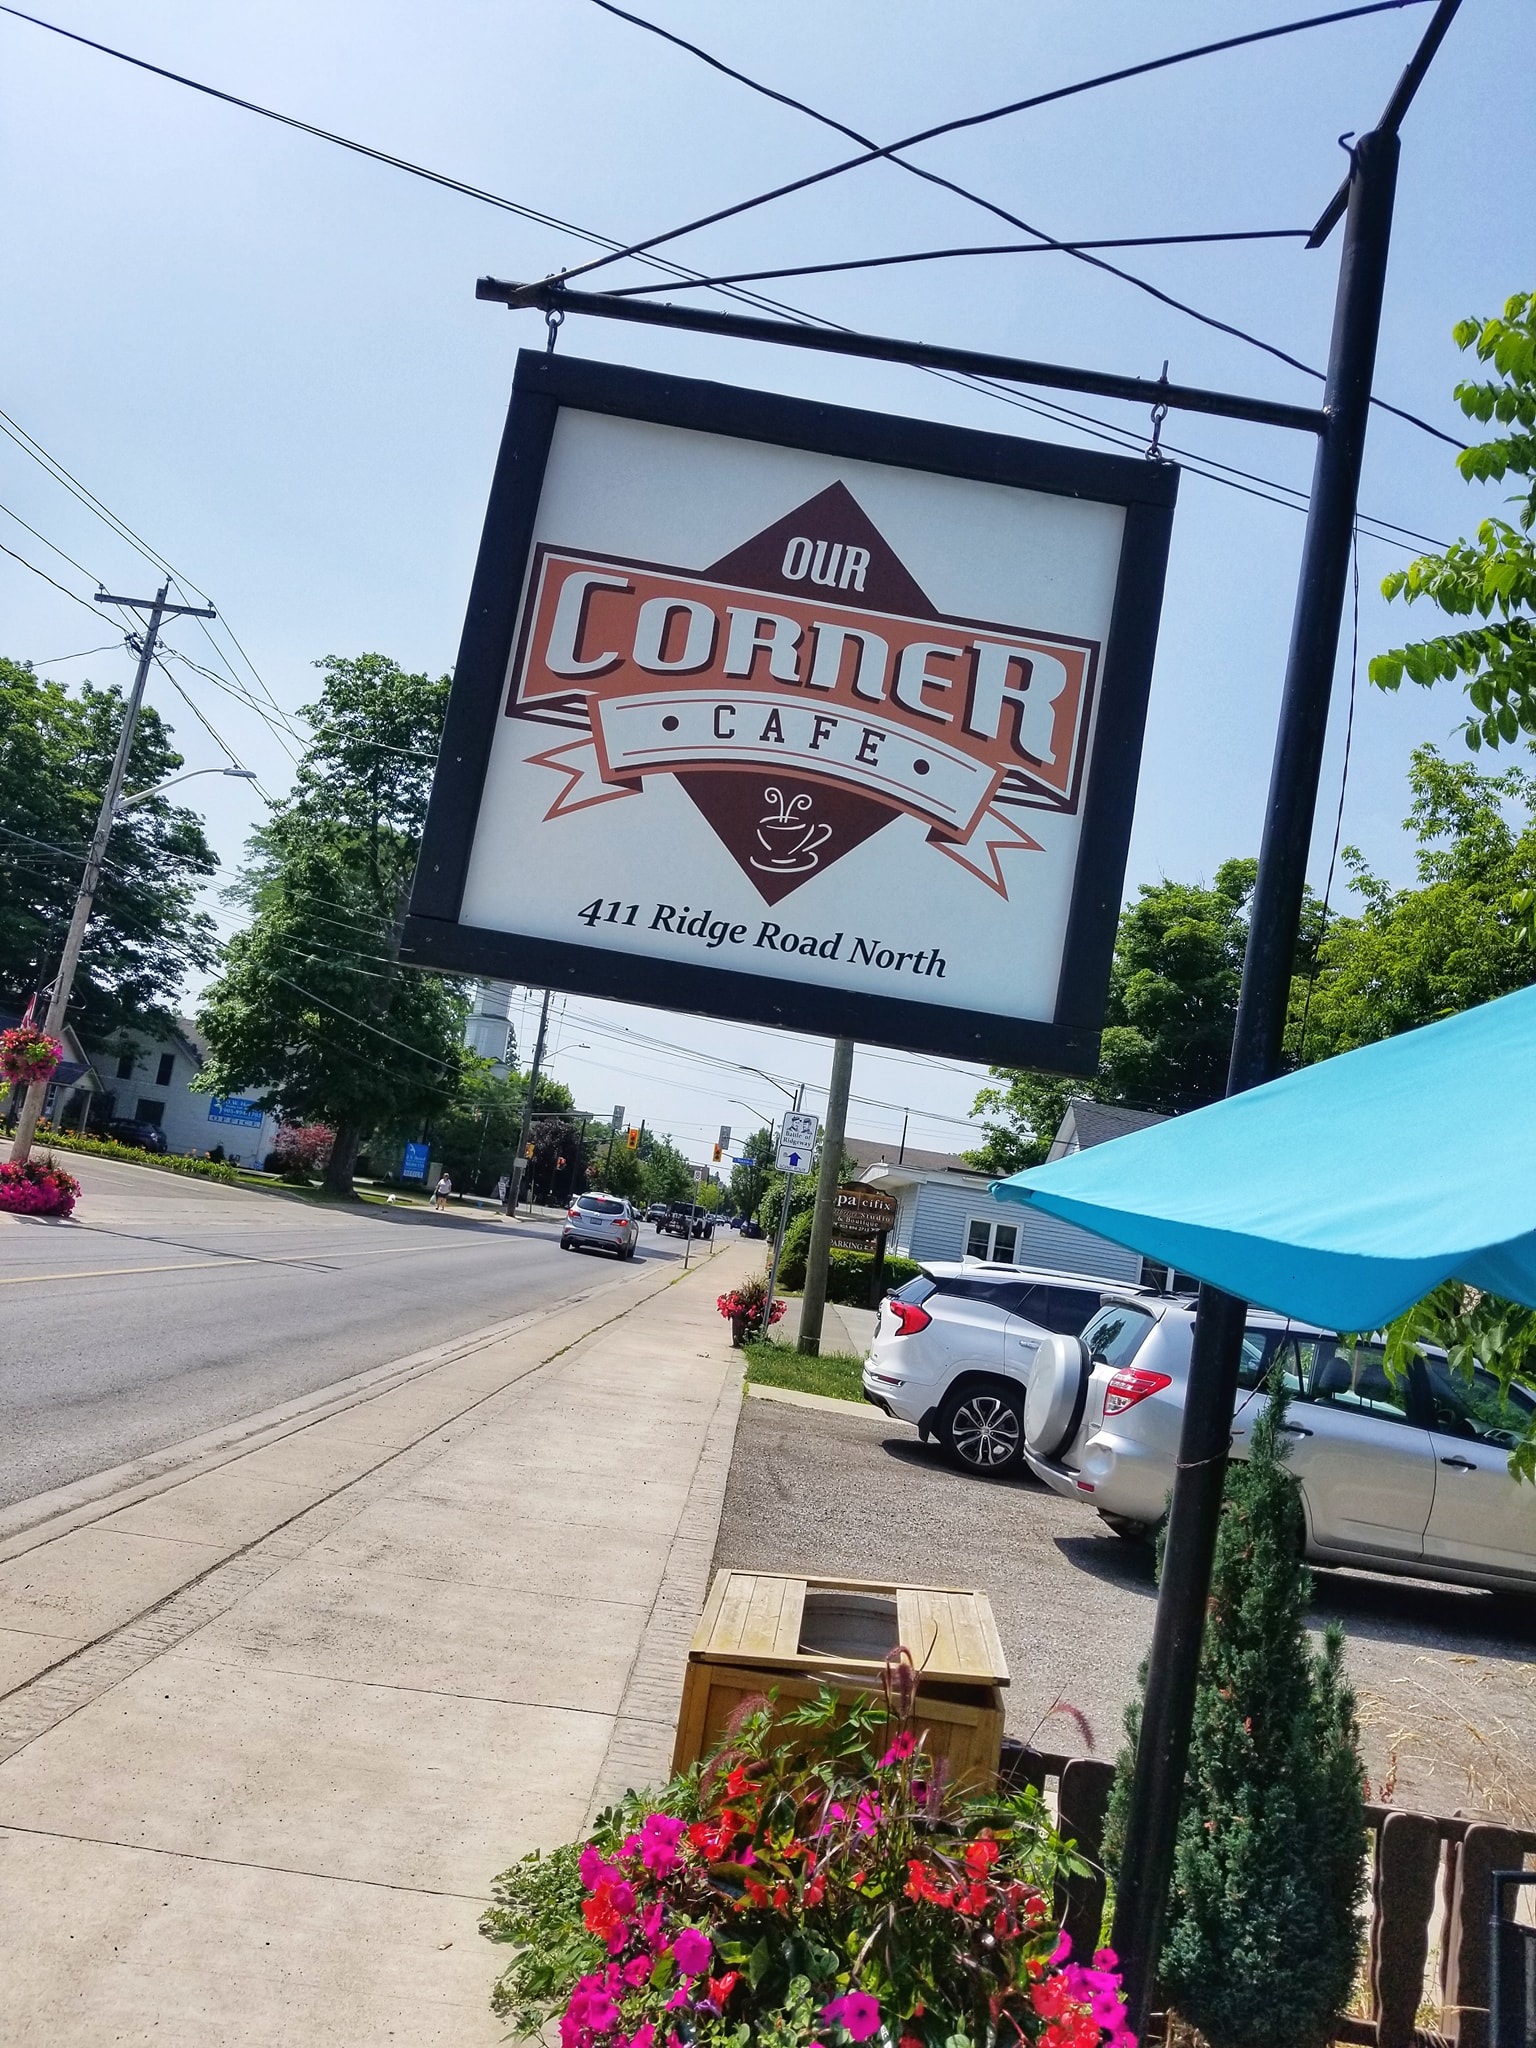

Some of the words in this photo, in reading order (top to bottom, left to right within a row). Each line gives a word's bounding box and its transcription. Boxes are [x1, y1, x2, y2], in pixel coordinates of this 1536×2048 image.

[781, 536, 871, 592] OUR
[544, 570, 1070, 766] CORNER
[712, 704, 887, 768] CAFE
[577, 897, 638, 928] 411
[648, 901, 747, 949] Ridge
[753, 921, 841, 961] Road
[847, 937, 948, 979] North
[783, 1136, 812, 1147] Ridgeway
[785, 1130, 802, 1138] Battle
[845, 1216, 879, 1228] Boutique
[860, 1212, 891, 1222] Studio
